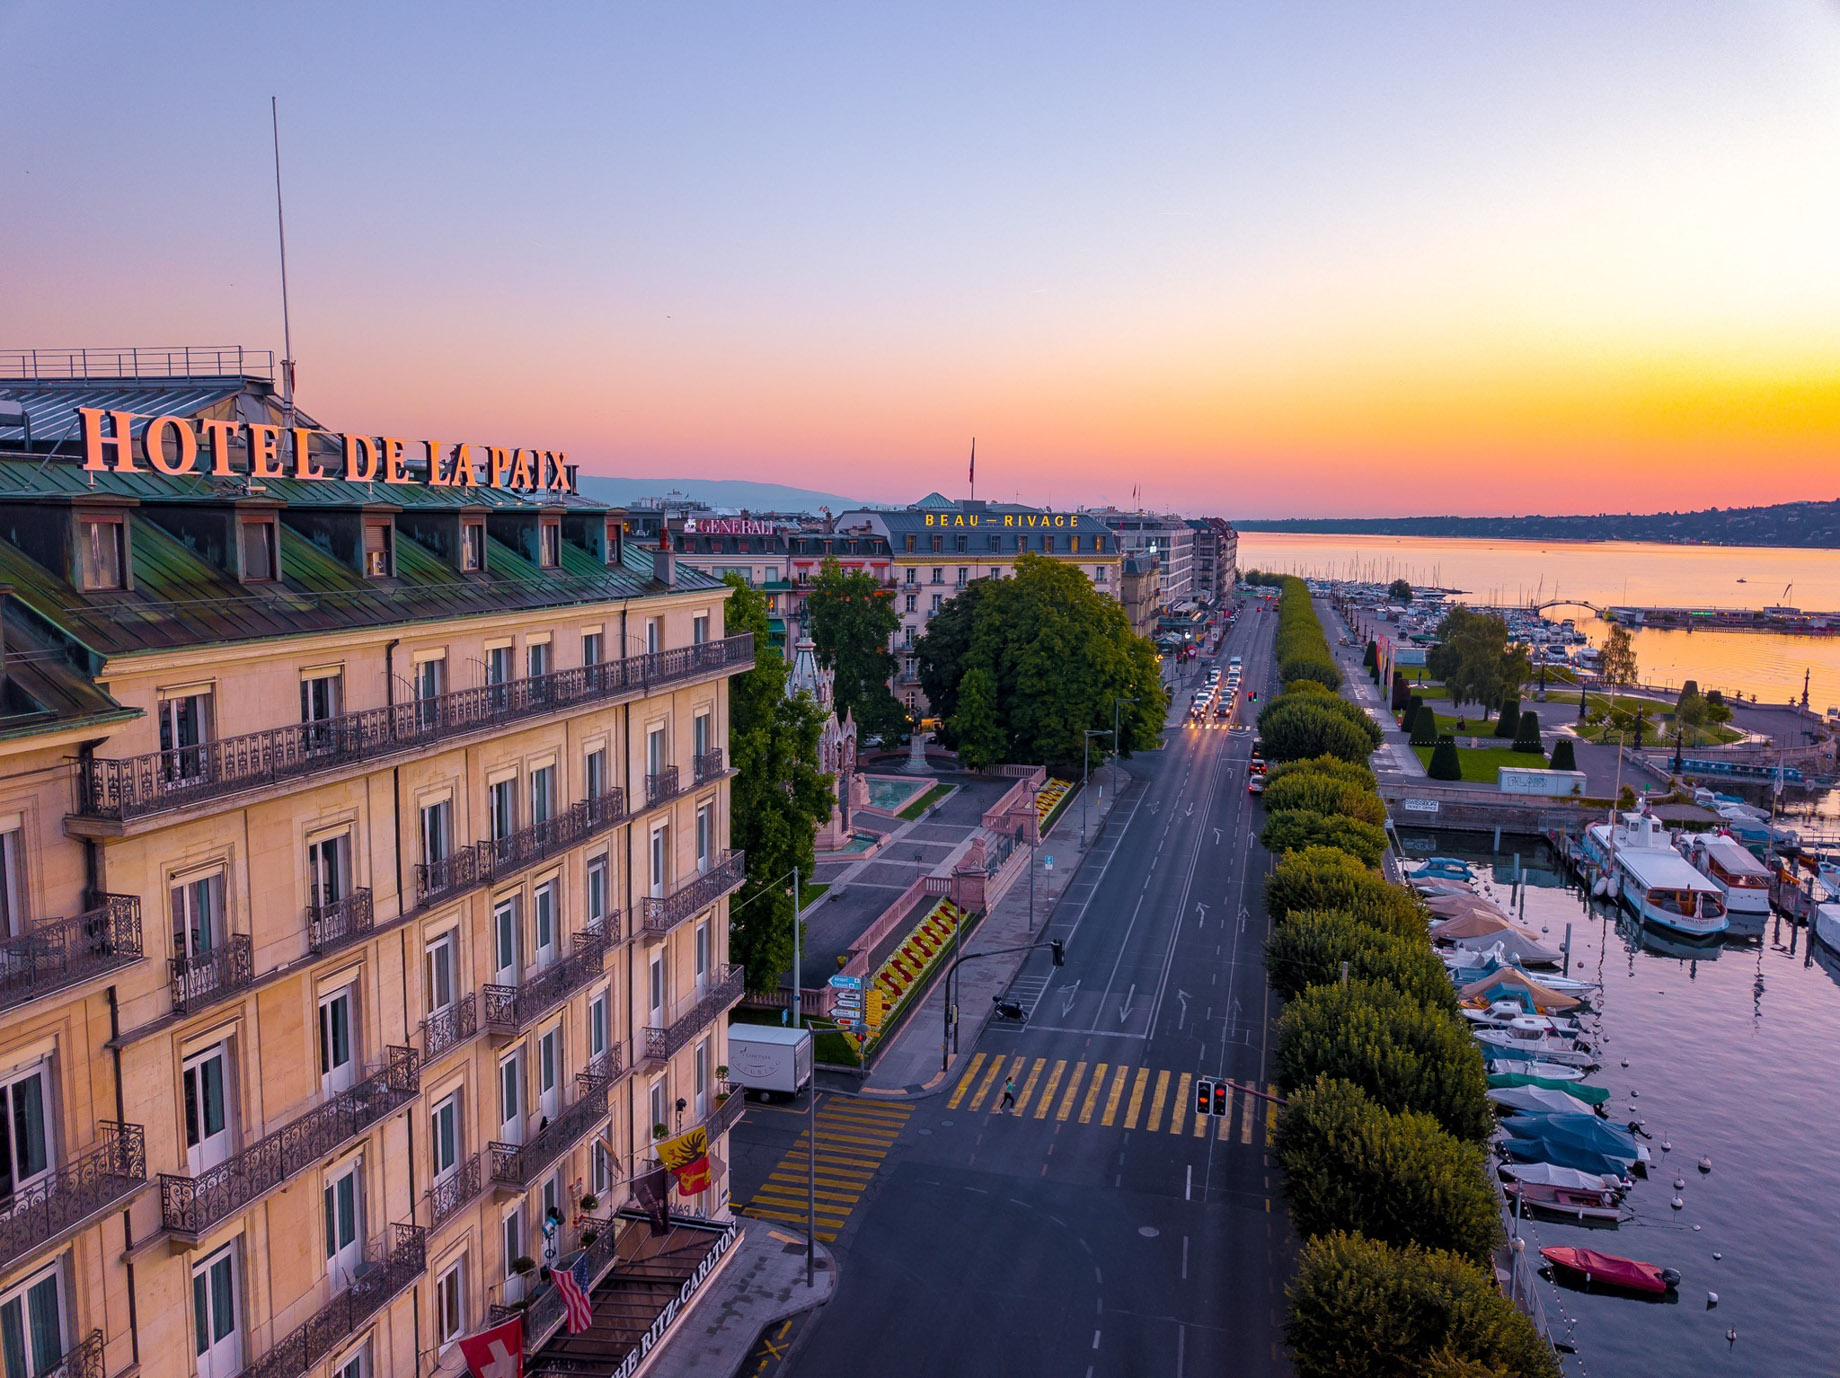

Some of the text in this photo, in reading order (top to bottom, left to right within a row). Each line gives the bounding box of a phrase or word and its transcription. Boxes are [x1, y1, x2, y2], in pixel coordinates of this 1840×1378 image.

[78, 406, 571, 490] HOTEL DE LA PAIX
[700, 519, 774, 535] GENERALI
[611, 1348, 638, 1378] HE
